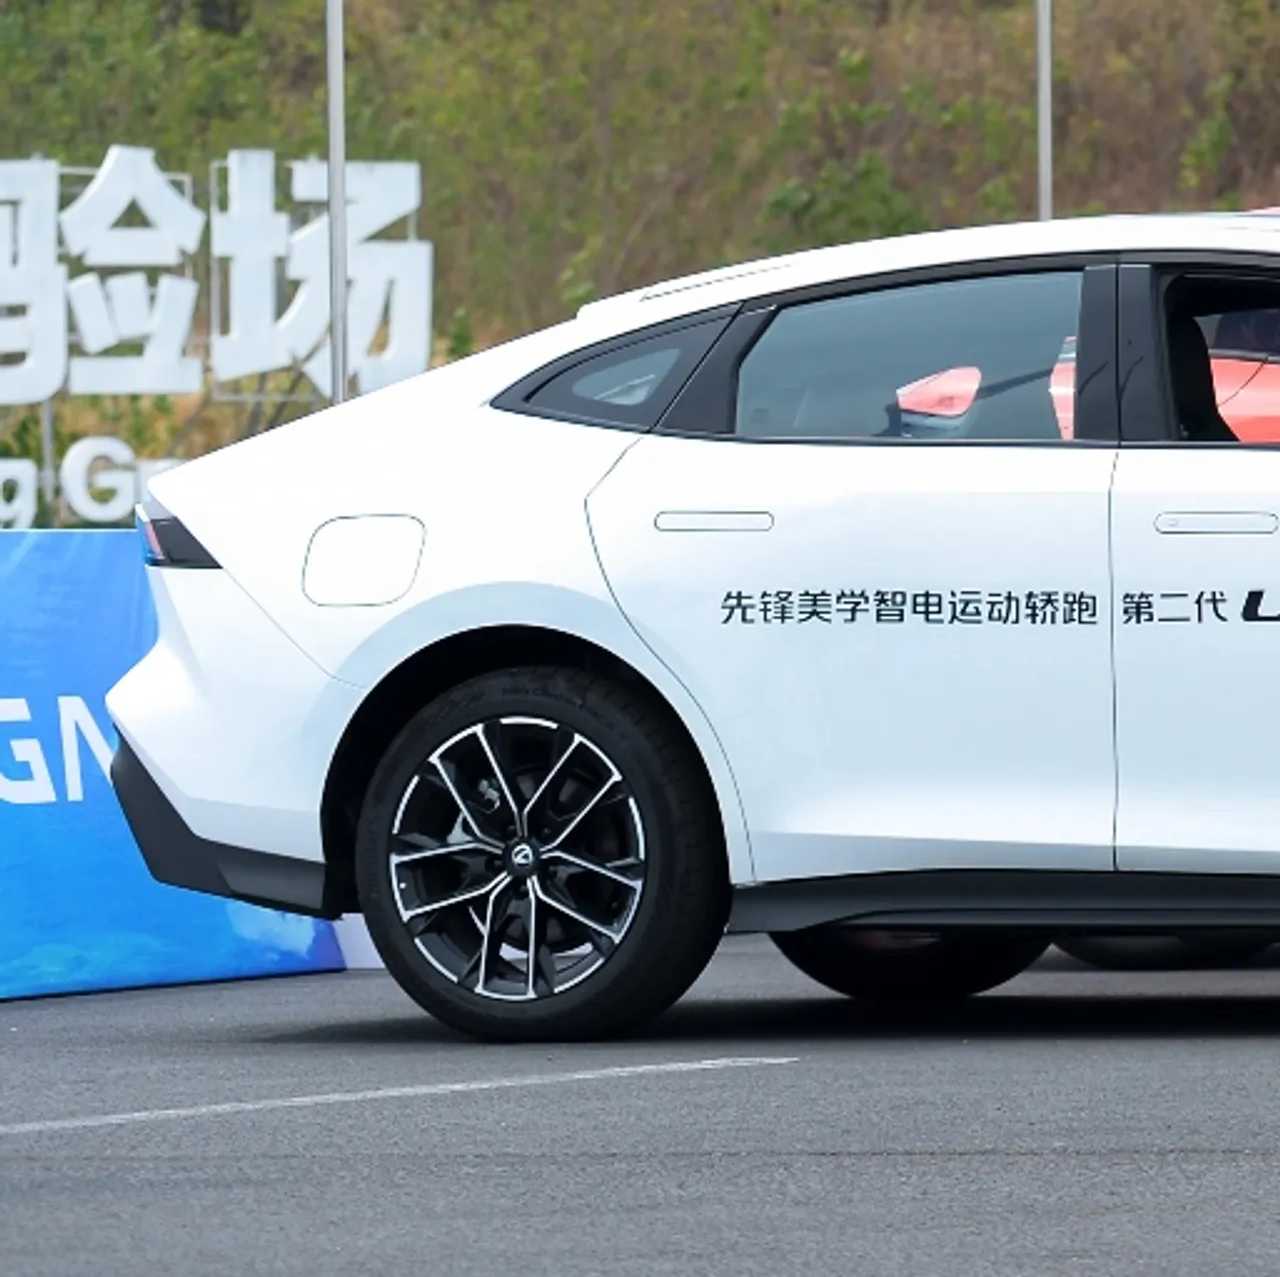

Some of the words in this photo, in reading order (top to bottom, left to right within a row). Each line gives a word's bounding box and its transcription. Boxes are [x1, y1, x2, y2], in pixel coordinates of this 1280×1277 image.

[720, 589, 1099, 625] 先锋美学智电运动轿跑
[1121, 590, 1228, 625] 第二代
